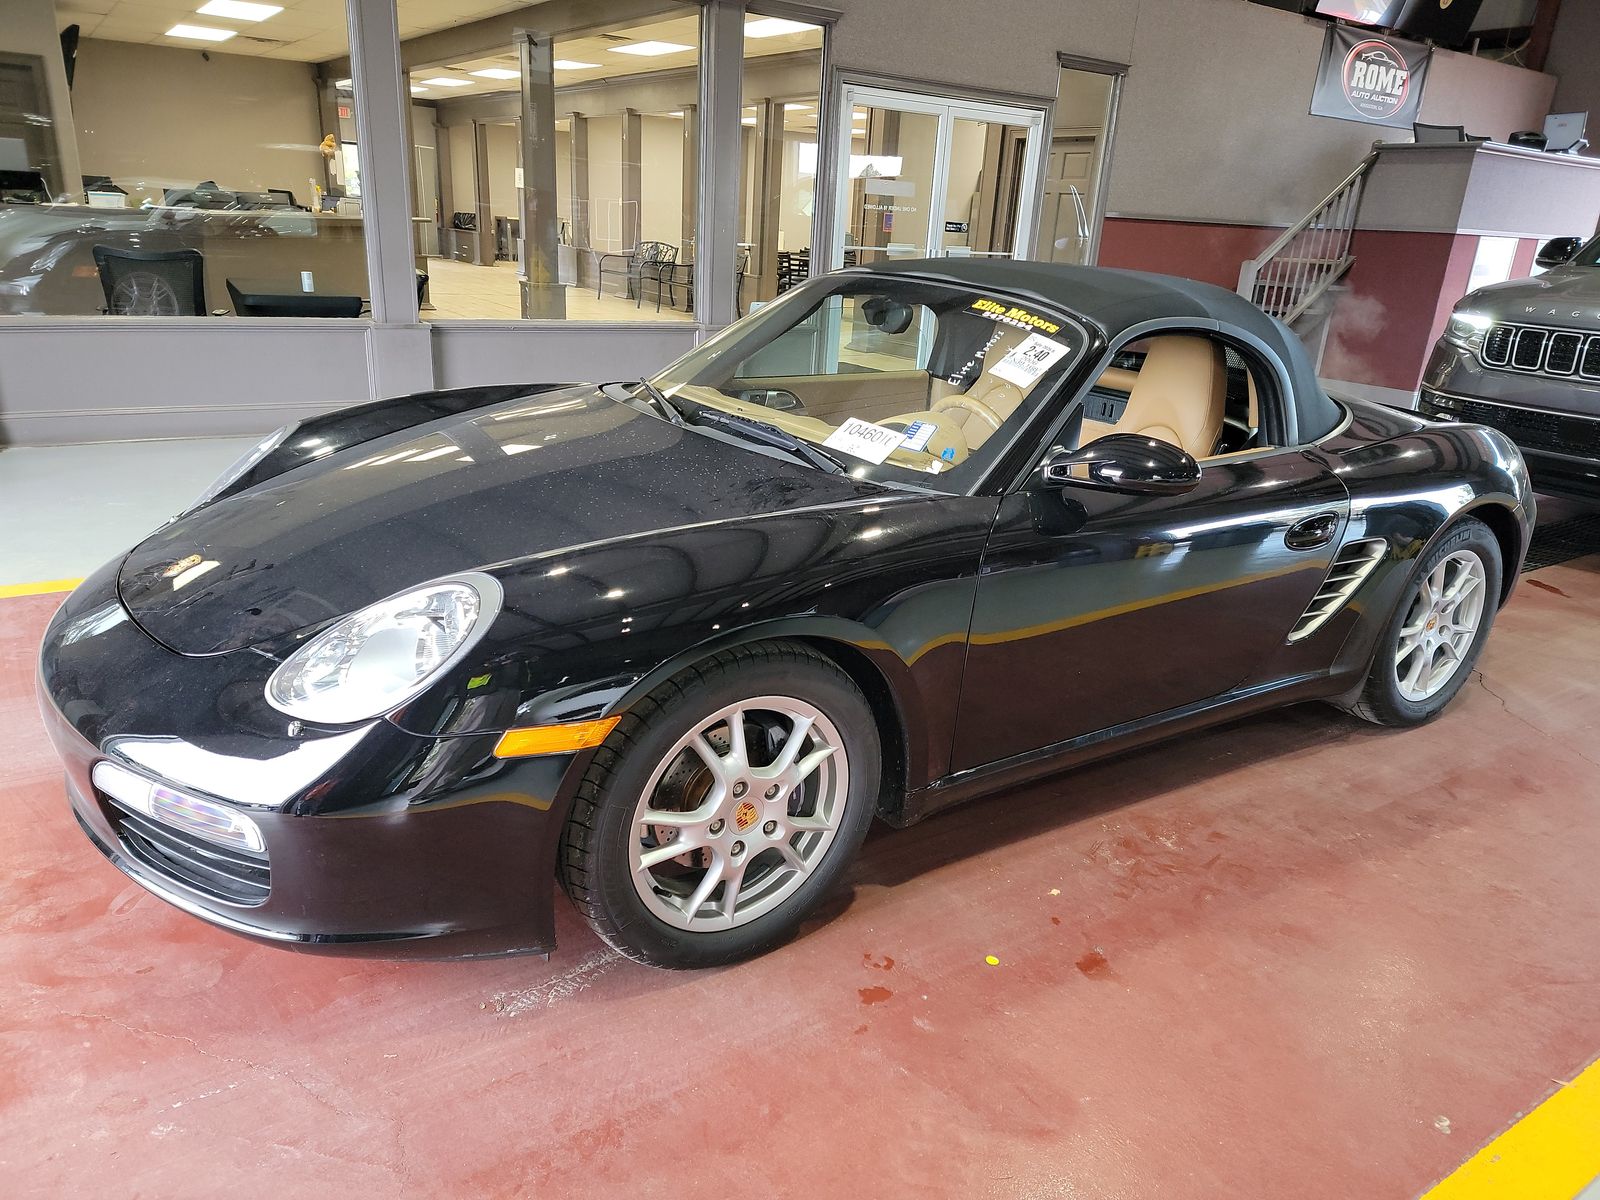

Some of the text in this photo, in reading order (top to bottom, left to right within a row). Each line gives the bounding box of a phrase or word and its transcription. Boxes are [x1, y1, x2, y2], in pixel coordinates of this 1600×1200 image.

[1350, 60, 1408, 96] ROME
[1351, 90, 1399, 105] AUTO AUCTION
[971, 298, 1060, 334] Elite Motors
[1023, 345, 1050, 362] 2:40
[947, 359, 975, 386] Elite
